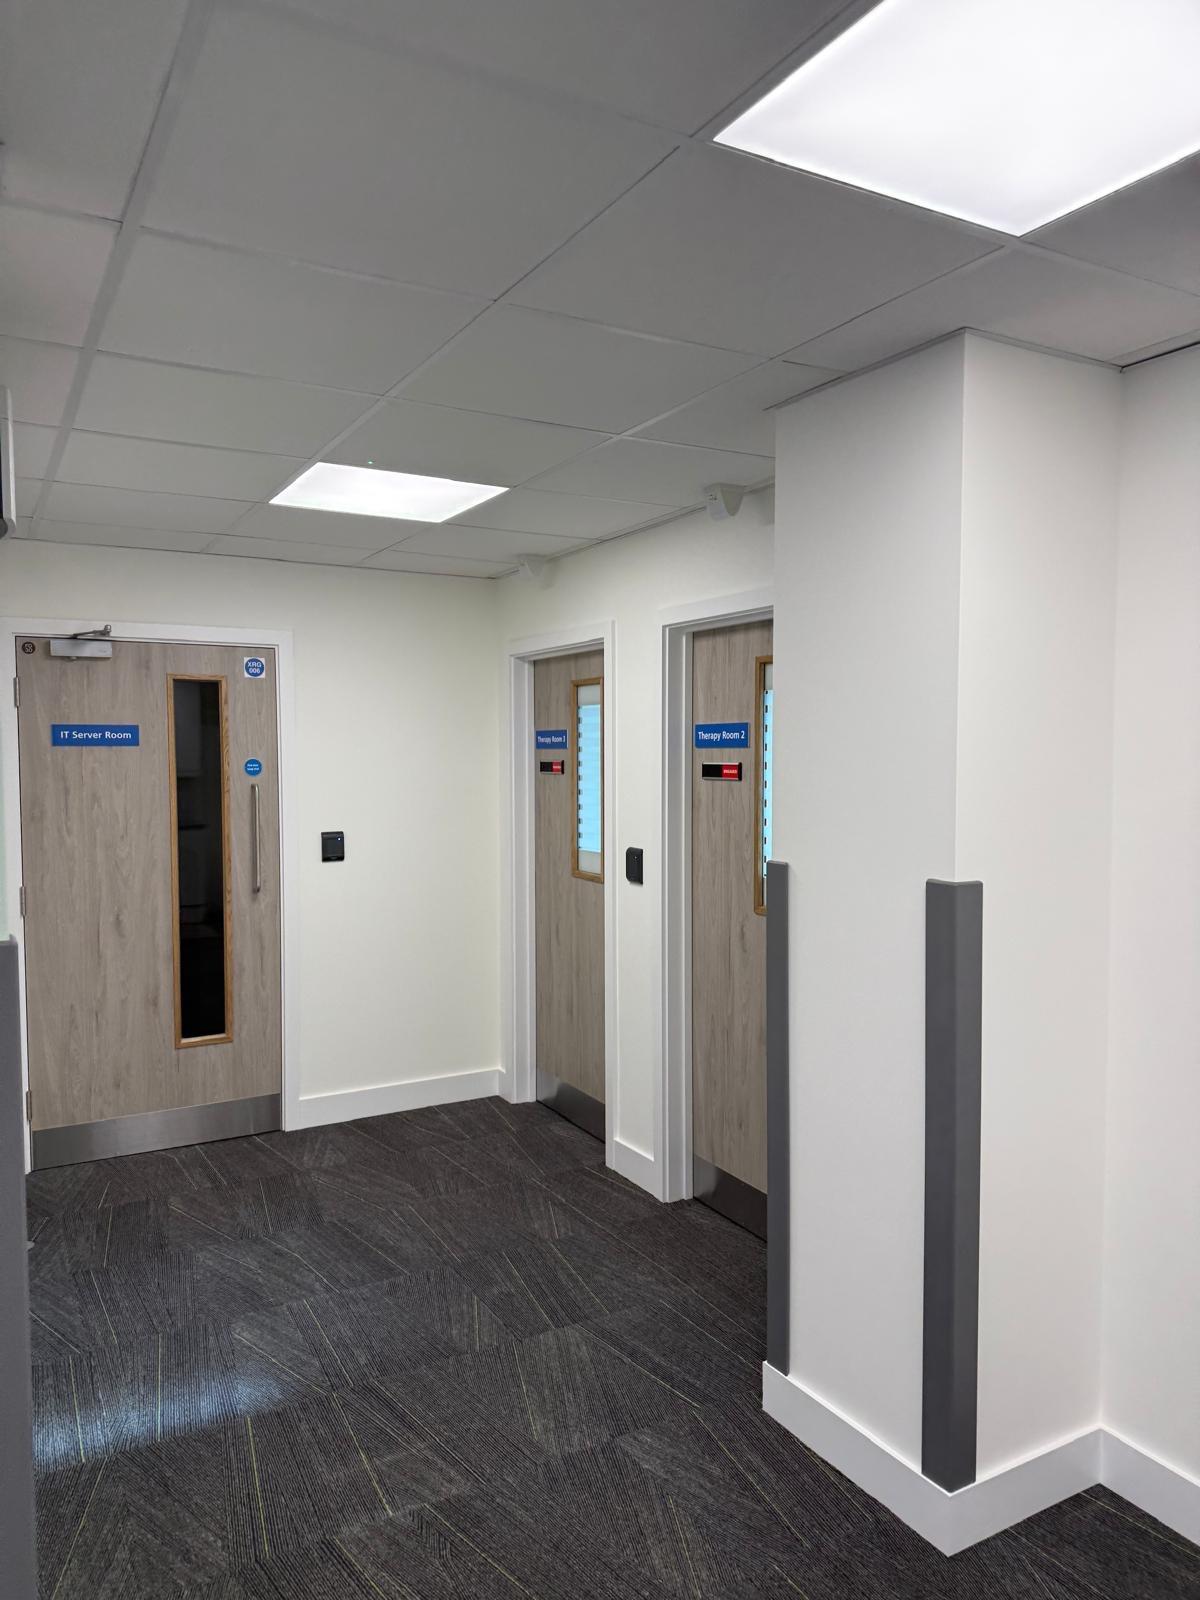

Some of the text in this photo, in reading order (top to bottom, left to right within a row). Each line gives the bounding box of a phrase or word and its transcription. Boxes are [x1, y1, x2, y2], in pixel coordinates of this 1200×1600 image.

[60, 730, 132, 739] IT Server Room
[698, 730, 745, 741] Therapy Room 2
[537, 735, 551, 744] Therapy
[551, 735, 562, 743] Room
